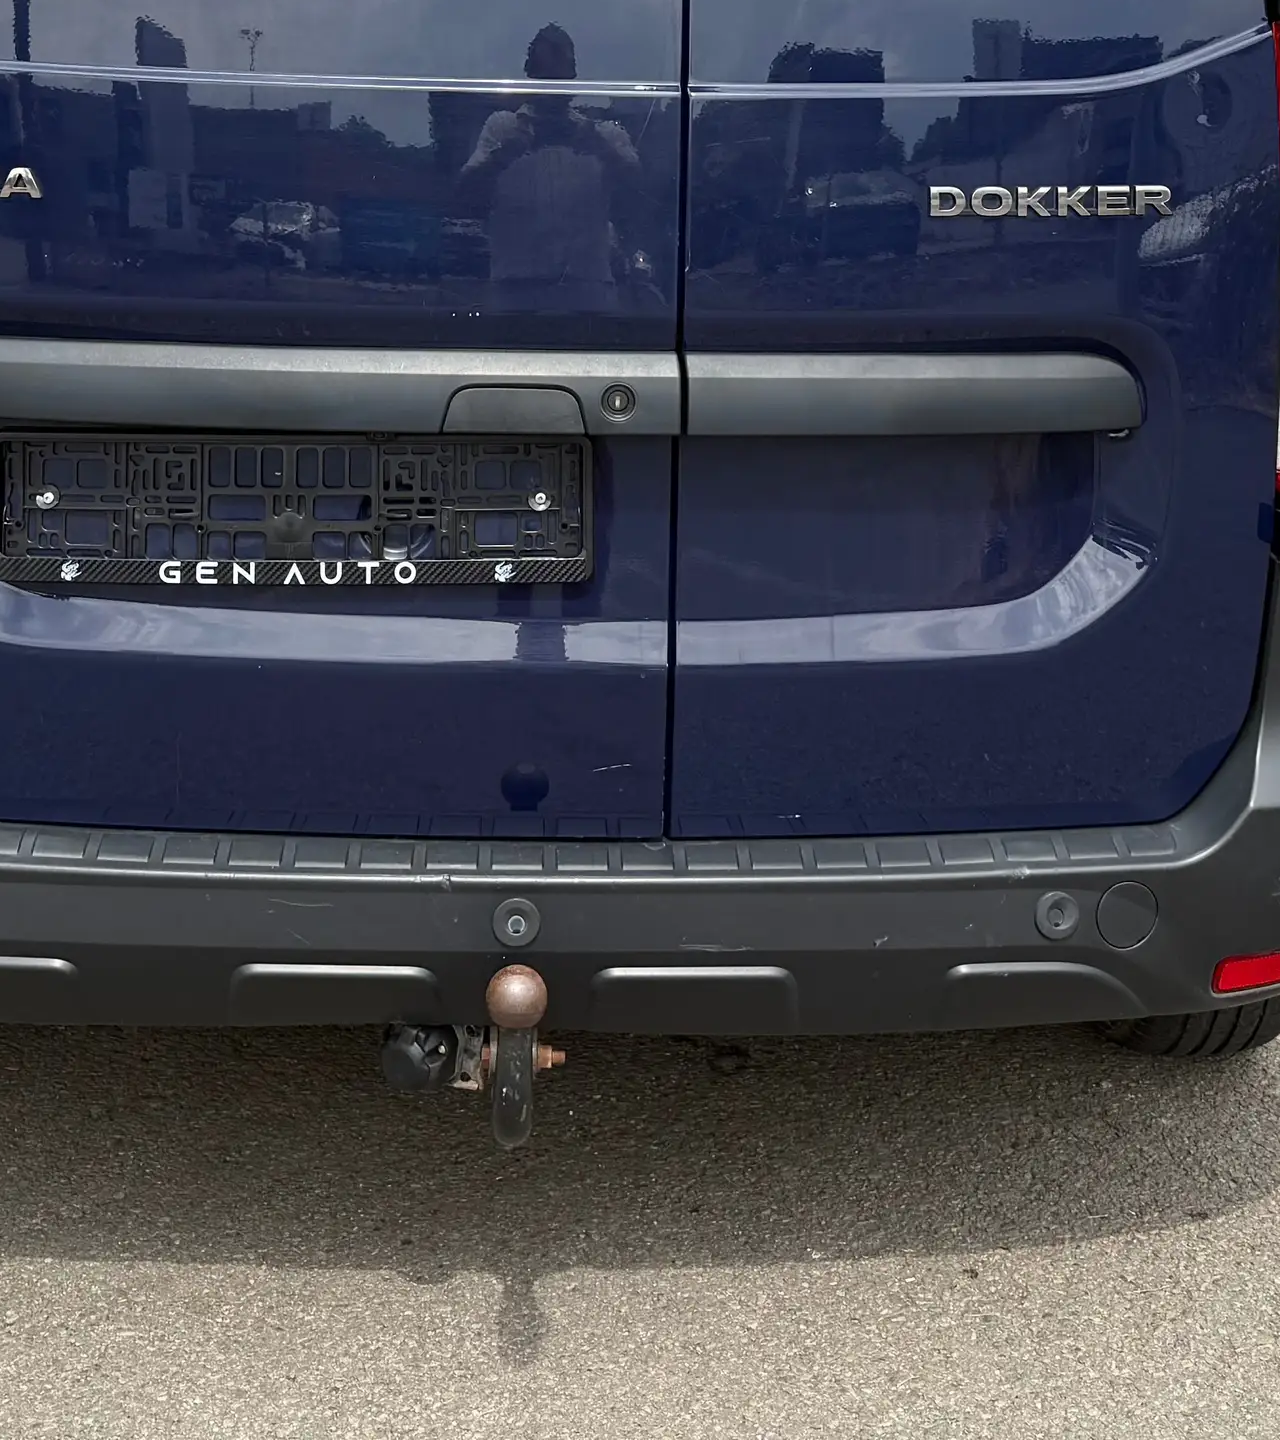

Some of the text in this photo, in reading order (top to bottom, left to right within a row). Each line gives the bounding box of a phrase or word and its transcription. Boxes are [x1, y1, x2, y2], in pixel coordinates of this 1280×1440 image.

[929, 185, 1173, 217] DOKKER
[158, 560, 417, 585] GEN AUTO
